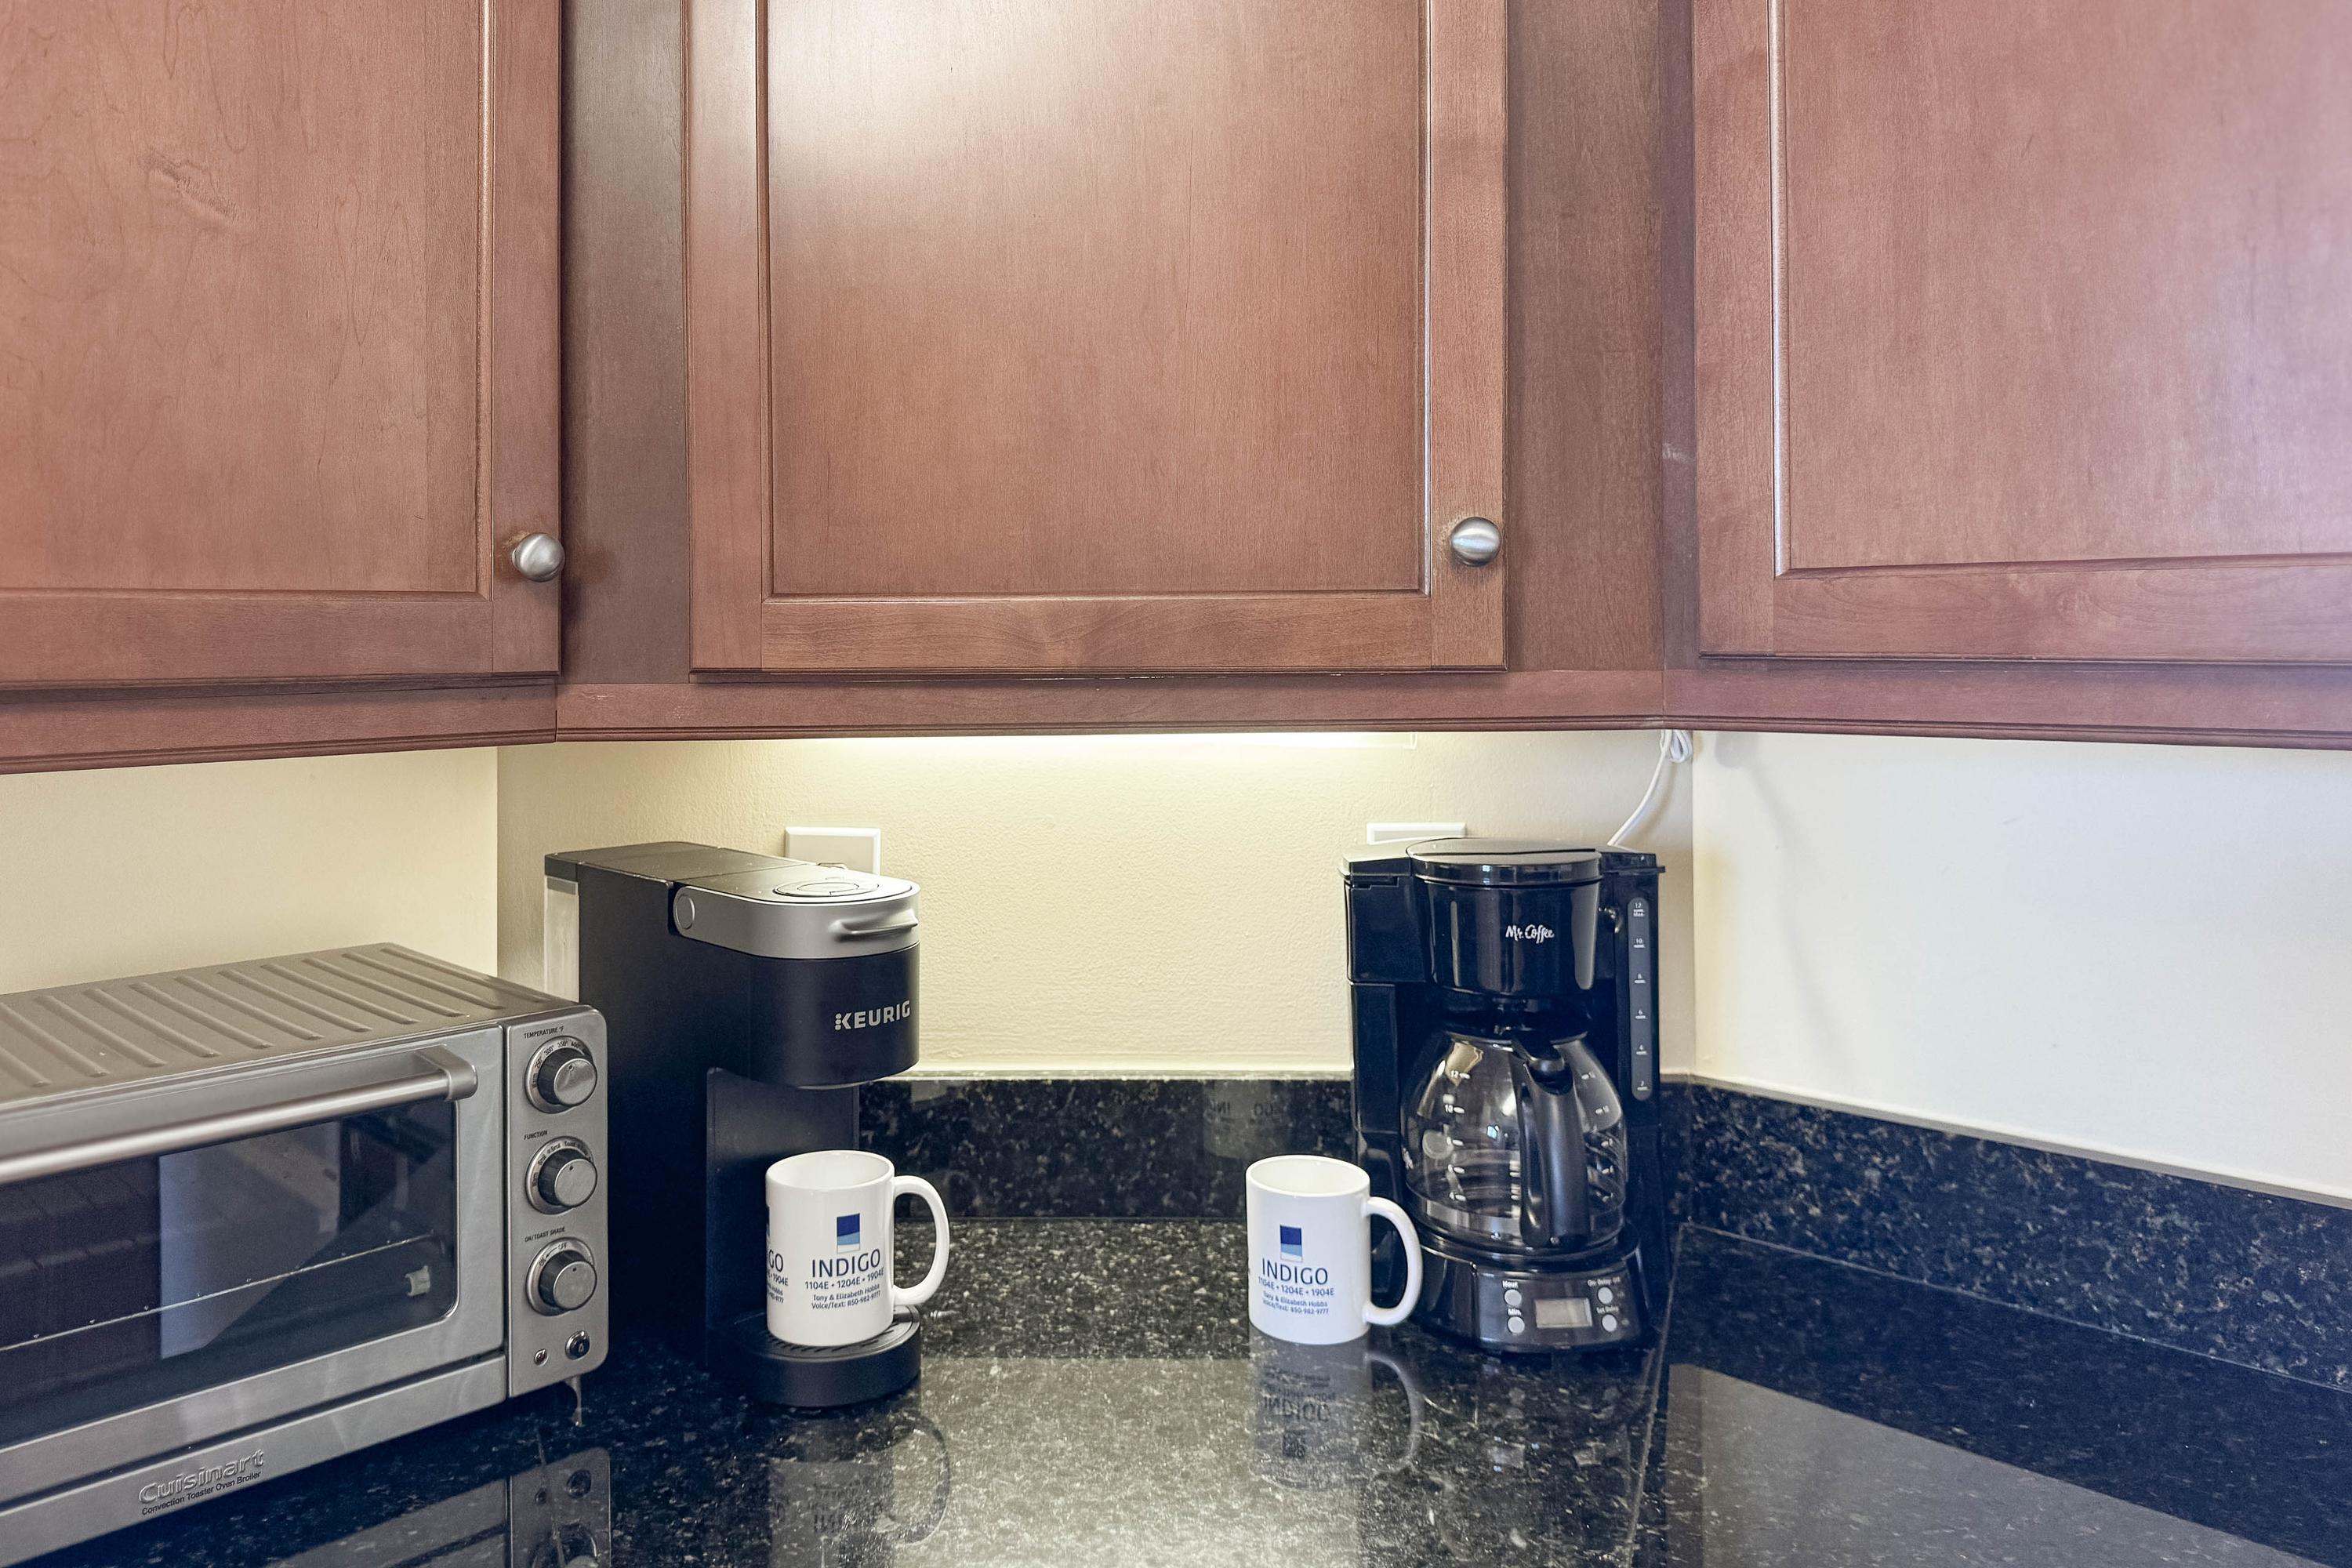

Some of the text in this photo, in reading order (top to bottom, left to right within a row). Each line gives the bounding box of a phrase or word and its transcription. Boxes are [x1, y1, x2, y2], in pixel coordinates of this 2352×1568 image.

[1505, 924, 1555, 944] Mr. Coffee
[834, 1000, 910, 1031] KEURIG
[524, 1026, 558, 1039] TEMPERATURE
[524, 1130, 548, 1140] FUNCTION
[811, 1249, 880, 1278] INDIGO
[1261, 1258, 1328, 1285] INDIGO
[805, 1267, 885, 1290] 1104E 1204E 1904E
[813, 1294, 828, 1303] Tony
[836, 1288, 864, 1300] Elizabeth
[1281, 1285, 1304, 1296] 1204E
[1312, 1287, 1335, 1297] 1904E
[138, 1449, 264, 1504] Cuisinart
[142, 1471, 261, 1515] Convection Toaster Oven Broiler
